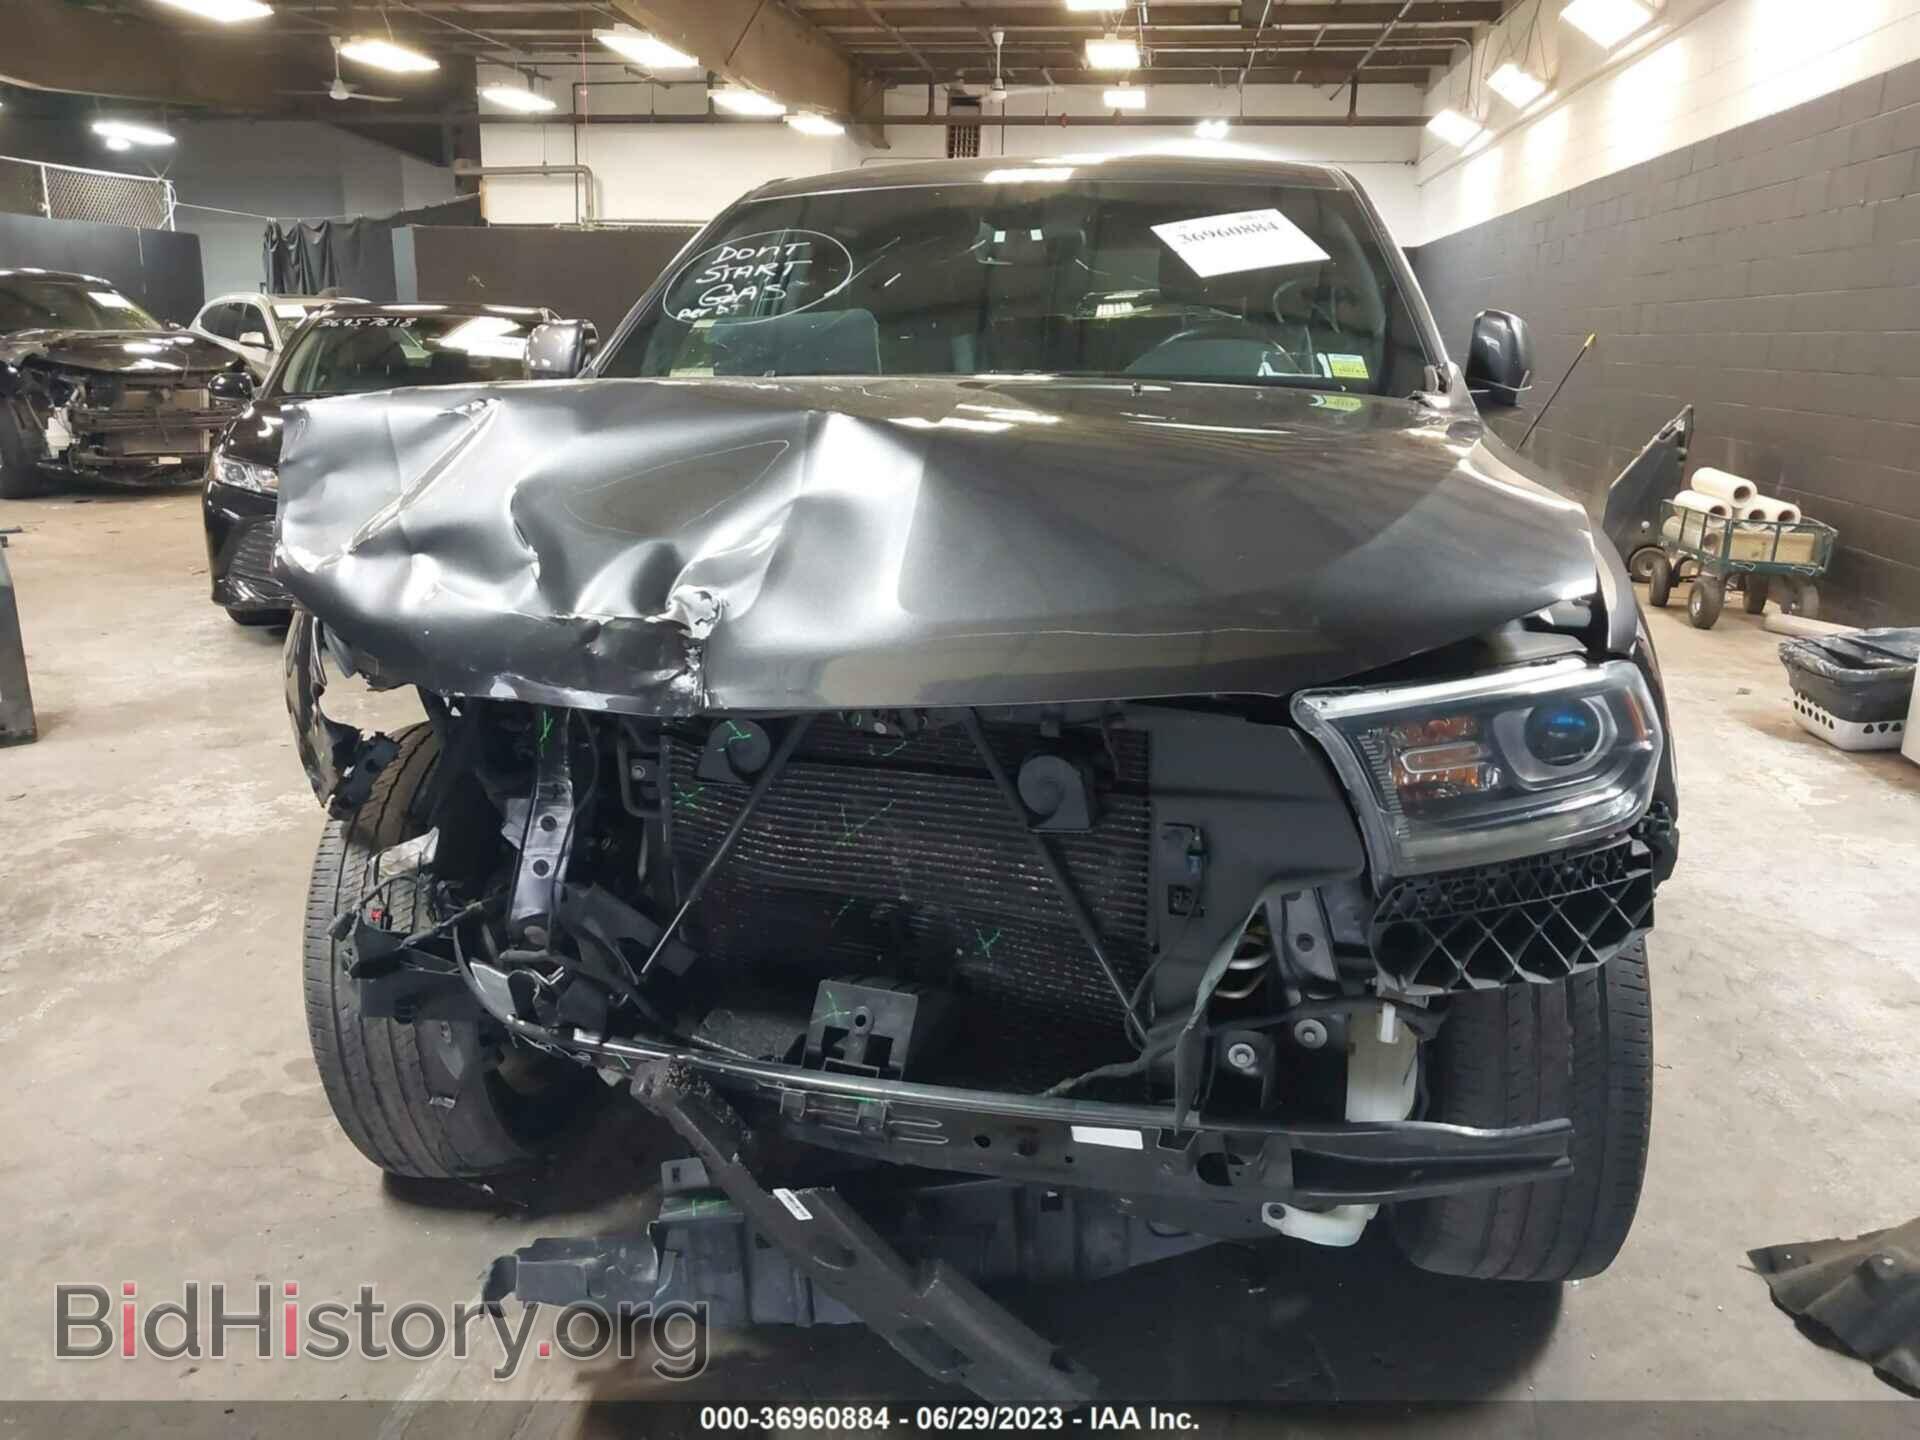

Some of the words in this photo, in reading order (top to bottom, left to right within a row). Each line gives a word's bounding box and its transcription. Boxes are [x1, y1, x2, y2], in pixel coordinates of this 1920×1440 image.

[1177, 221, 1280, 244] 36960884
[696, 260, 813, 283] START
[698, 284, 786, 306] GAS
